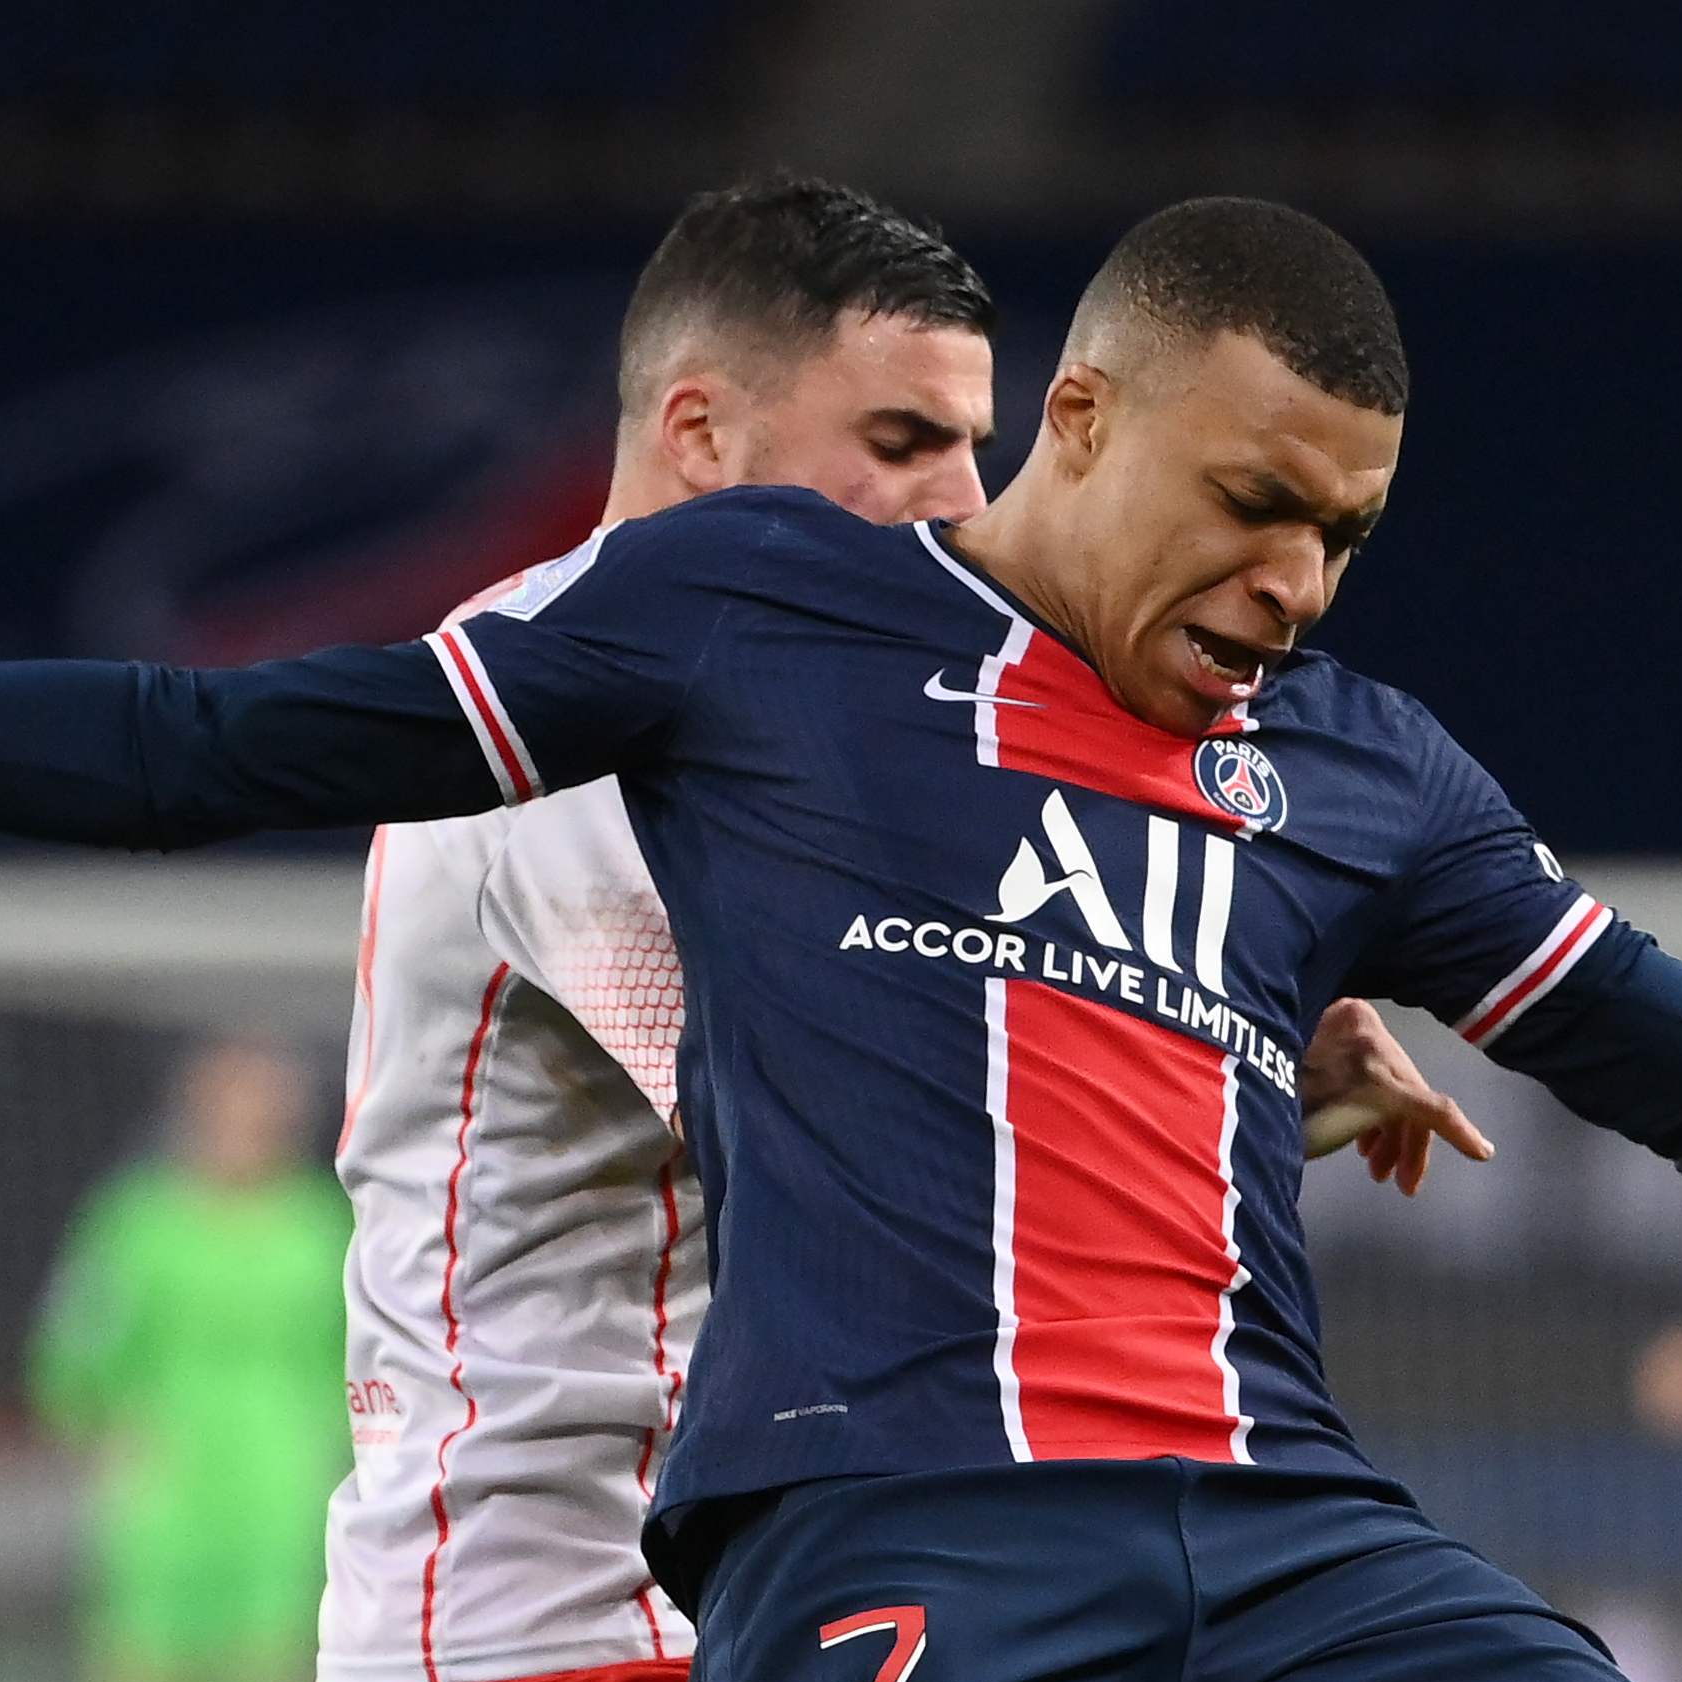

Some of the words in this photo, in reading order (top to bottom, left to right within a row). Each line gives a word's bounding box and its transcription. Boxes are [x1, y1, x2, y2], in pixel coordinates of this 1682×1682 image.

[1211, 740, 1271, 778] PARIS
[839, 915, 1026, 972] ACCOR
[1043, 943, 1145, 1004] LIVE
[1156, 977, 1297, 1099] LIMITLESS
